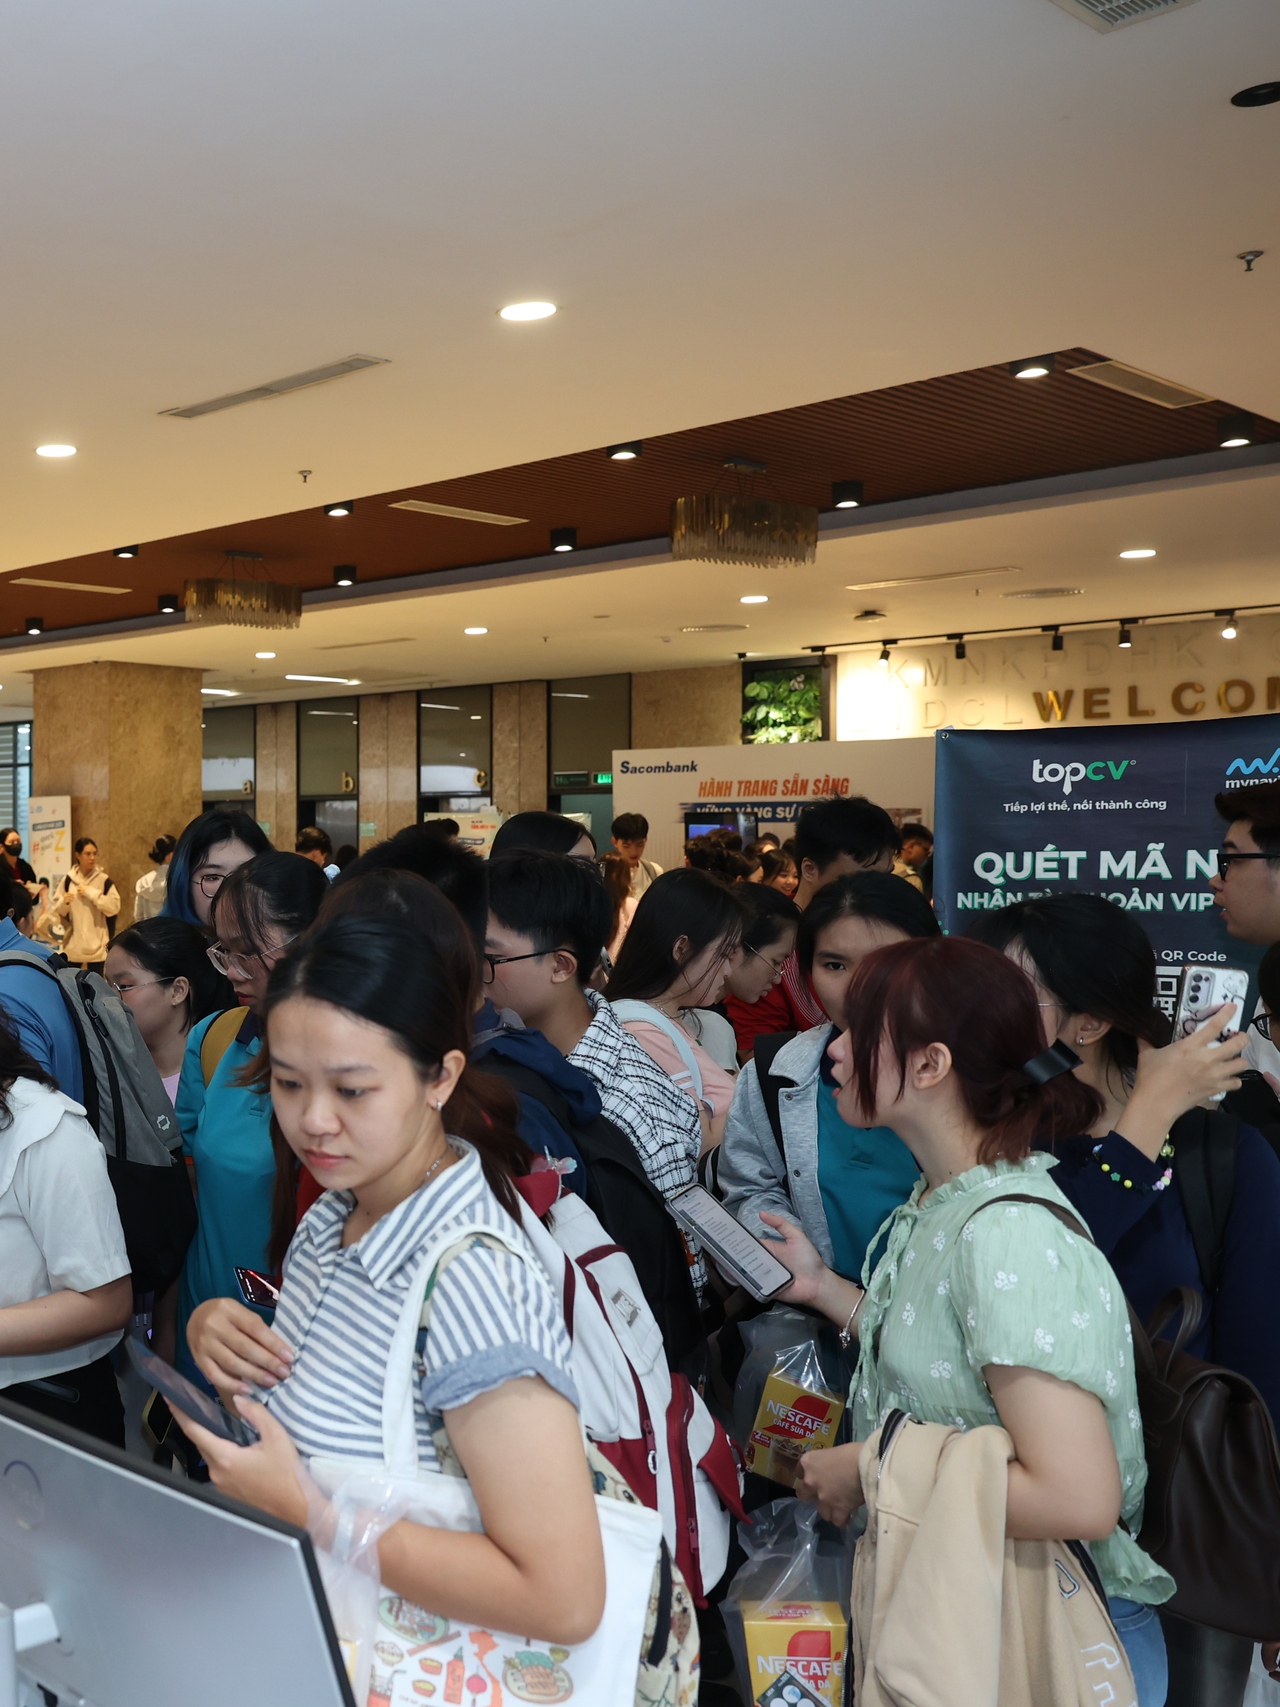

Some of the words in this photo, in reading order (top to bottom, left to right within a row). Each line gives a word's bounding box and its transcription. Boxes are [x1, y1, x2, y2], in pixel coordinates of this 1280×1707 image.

[620, 760, 698, 774] Sacombank
[698, 777, 733, 797] HÀNH
[736, 779, 778, 797] TRANG
[812, 774, 850, 796] SÀNG
[1225, 776, 1280, 789] mynav
[1003, 800, 1028, 813] Tiếp
[1030, 800, 1046, 813] lợi
[1095, 799, 1133, 810] thành
[1135, 798, 1167, 811] công
[973, 843, 1088, 886] QUÉT
[1098, 842, 1173, 880] MÃ
[1170, 892, 1215, 912] VIP
[1161, 950, 1184, 962] QR
[1187, 950, 1227, 962] Code
[766, 1399, 833, 1436] NESCAFÉ
